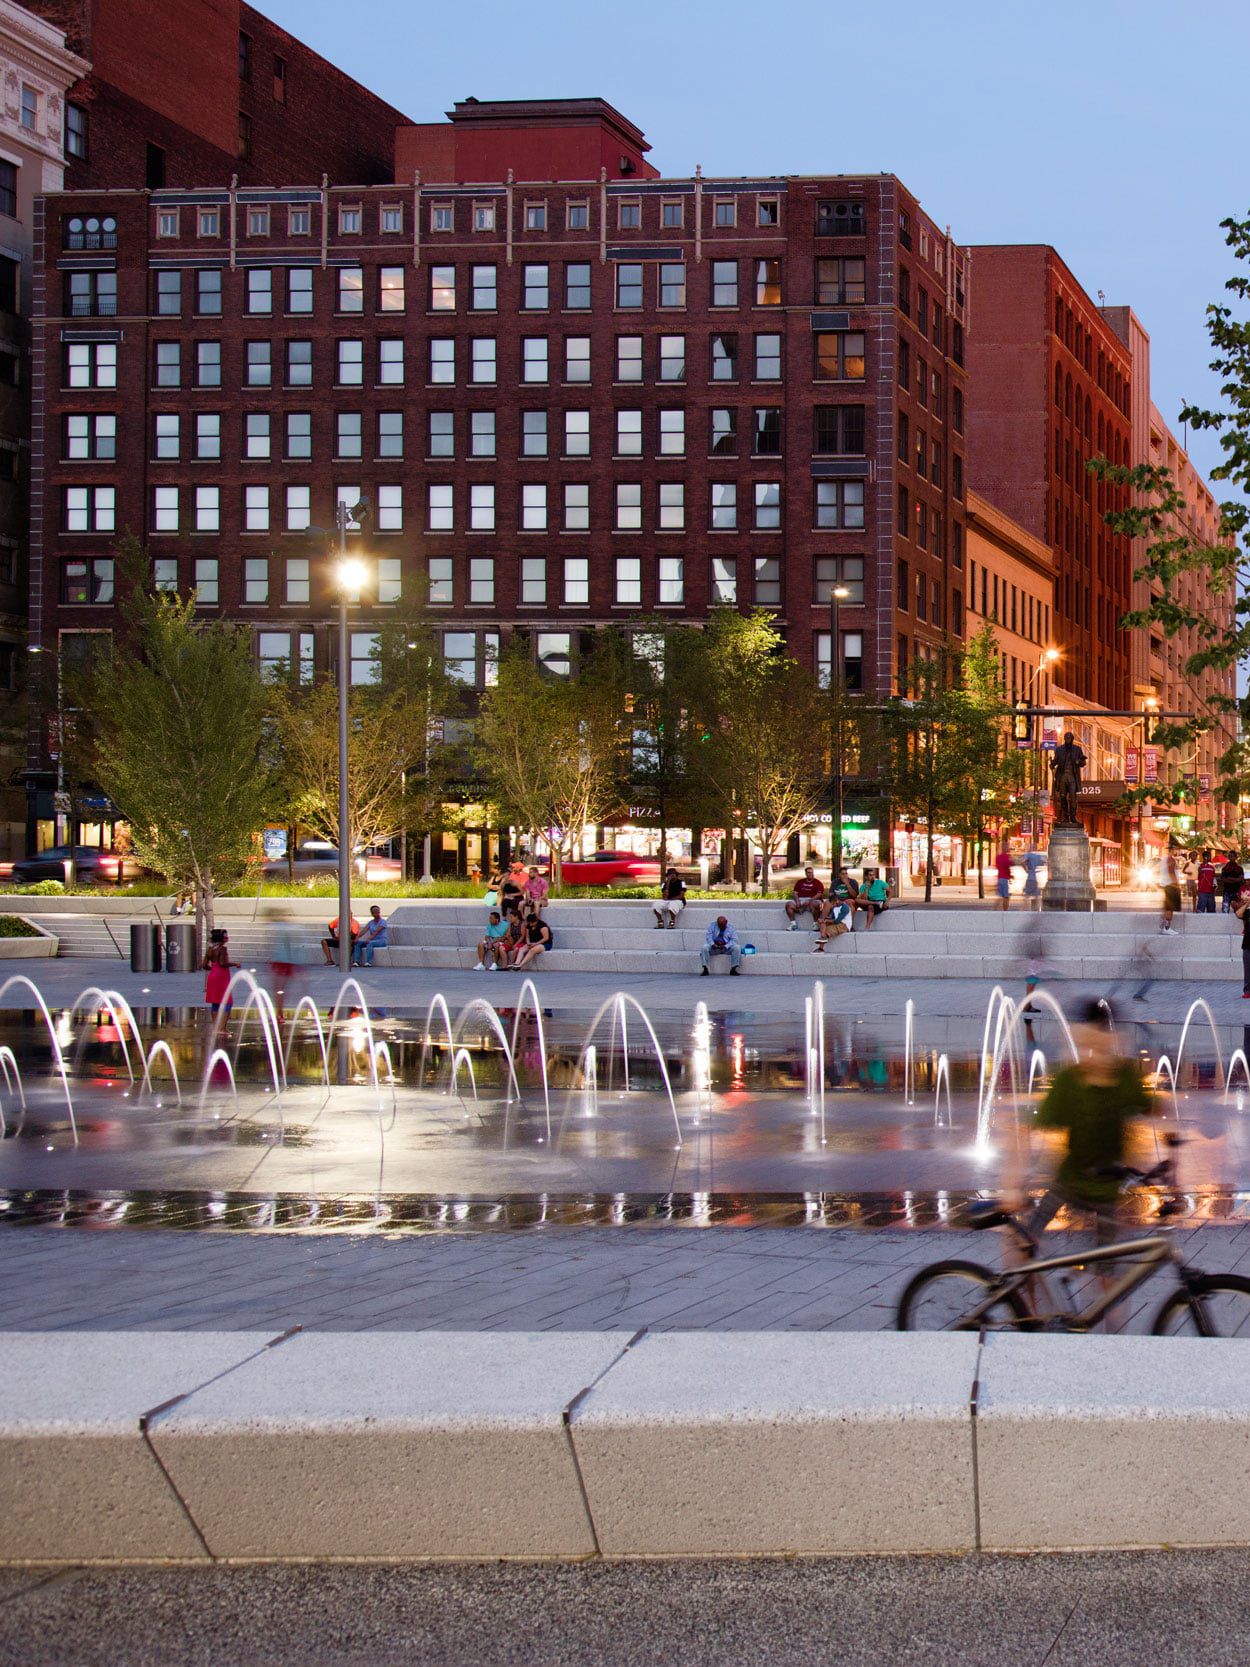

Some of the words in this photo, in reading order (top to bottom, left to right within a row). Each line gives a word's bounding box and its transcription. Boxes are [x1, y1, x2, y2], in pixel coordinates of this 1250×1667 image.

[1076, 786, 1102, 795] 025
[820, 814, 851, 823] COED
[852, 814, 870, 823] BEEF
